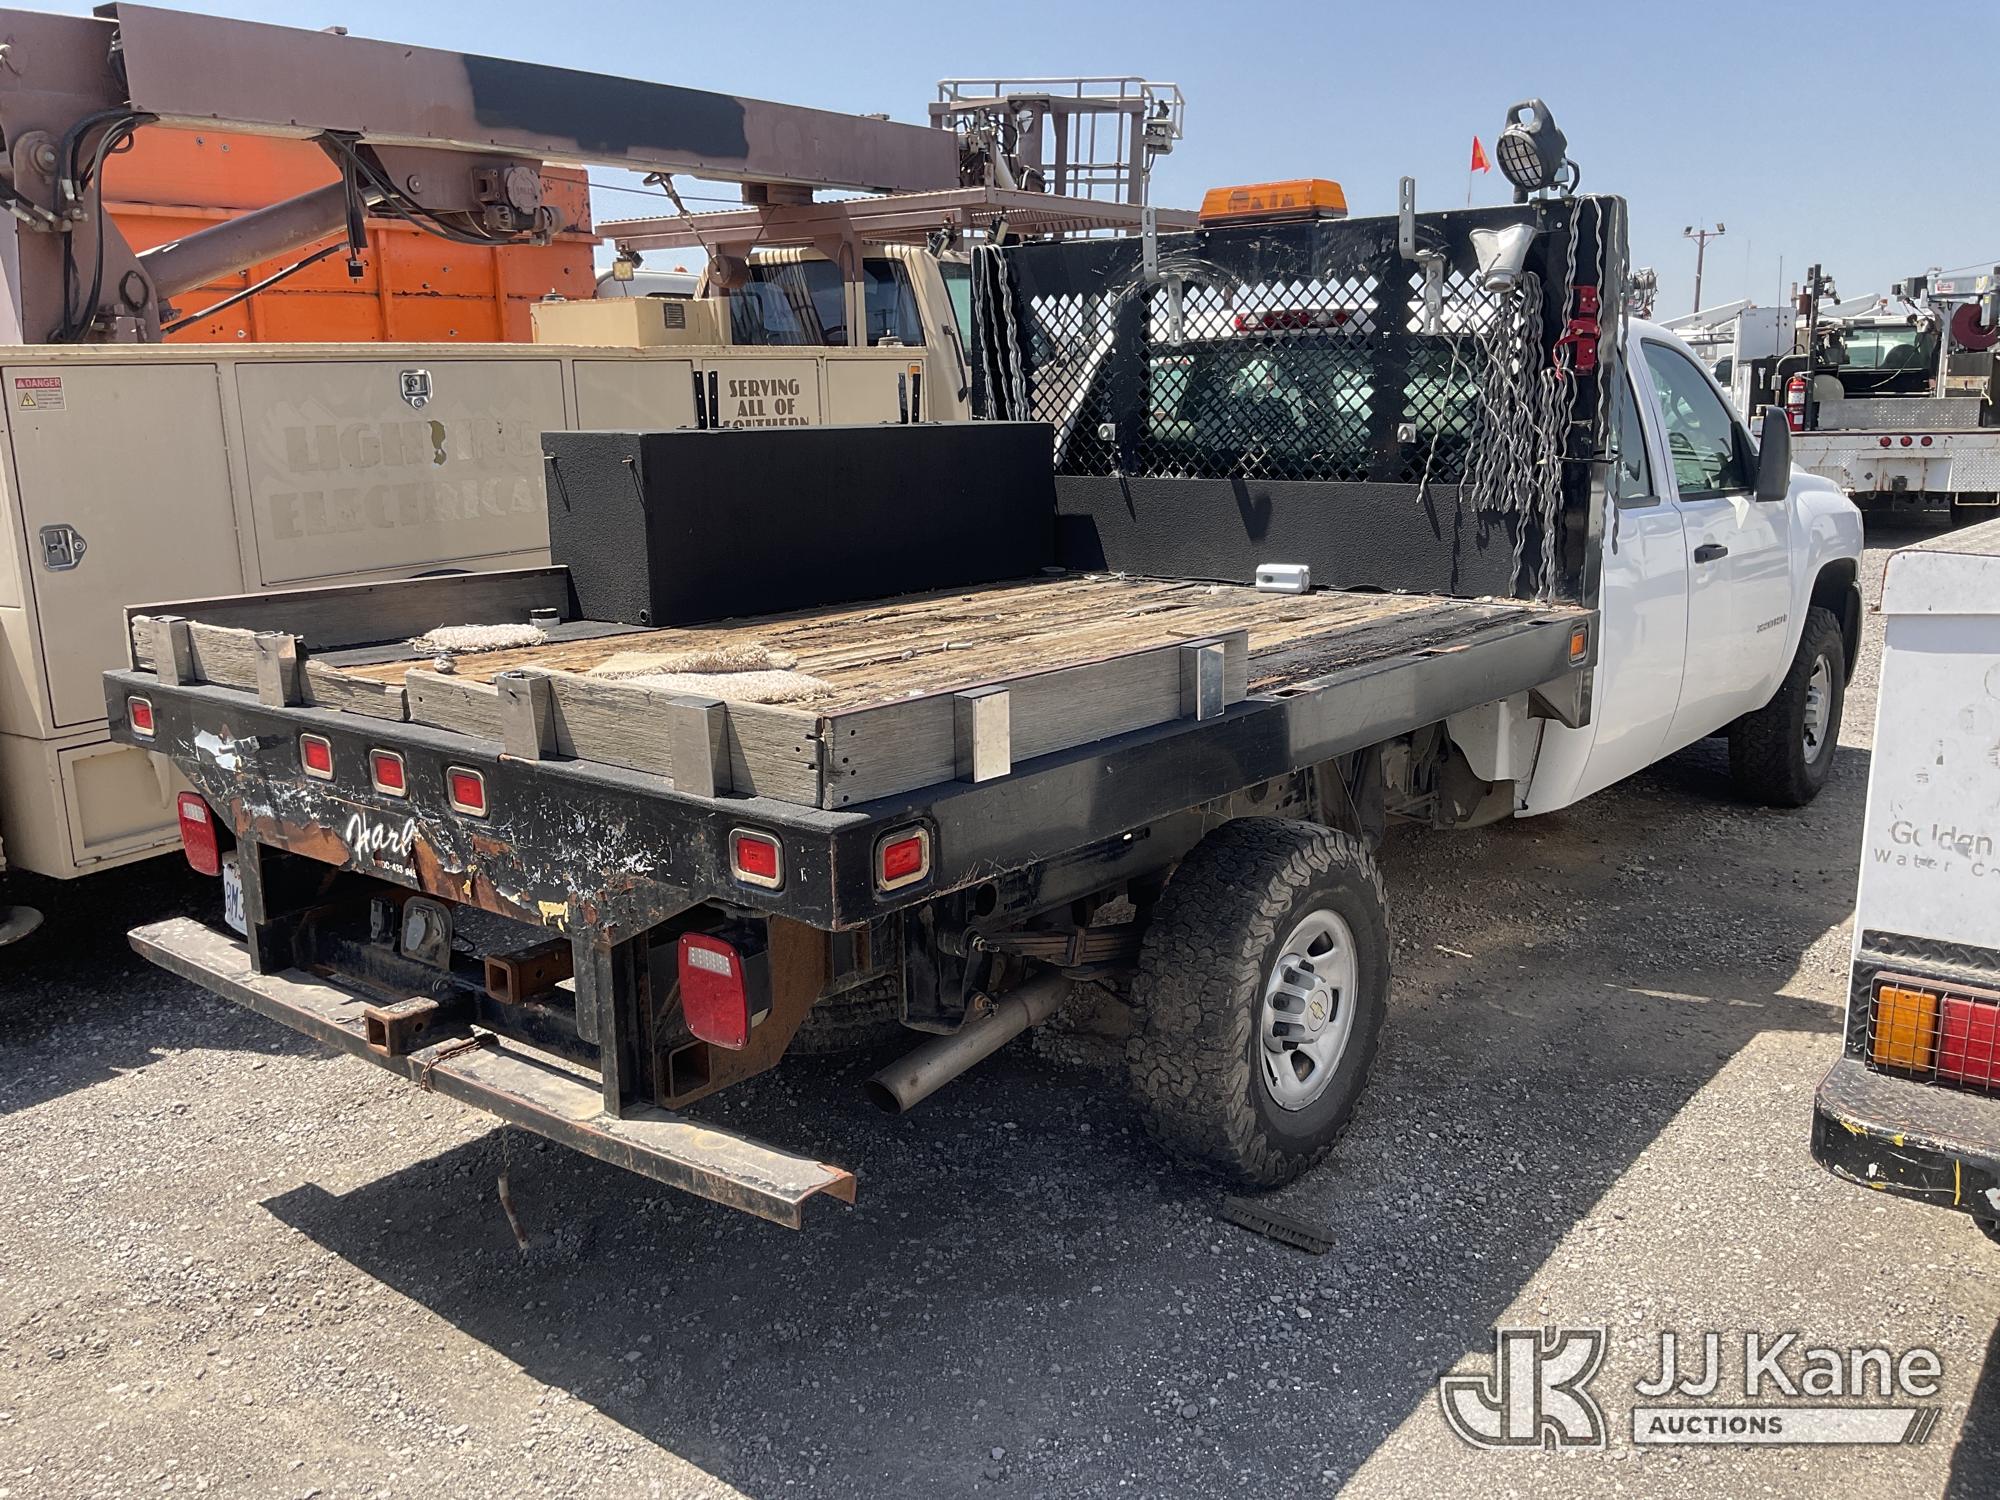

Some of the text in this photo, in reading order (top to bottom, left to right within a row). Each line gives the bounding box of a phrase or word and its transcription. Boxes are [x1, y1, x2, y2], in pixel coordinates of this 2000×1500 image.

[25, 378, 60, 388] DANGER
[728, 378, 800, 397] SERVING
[737, 398, 796, 417] ALL OF
